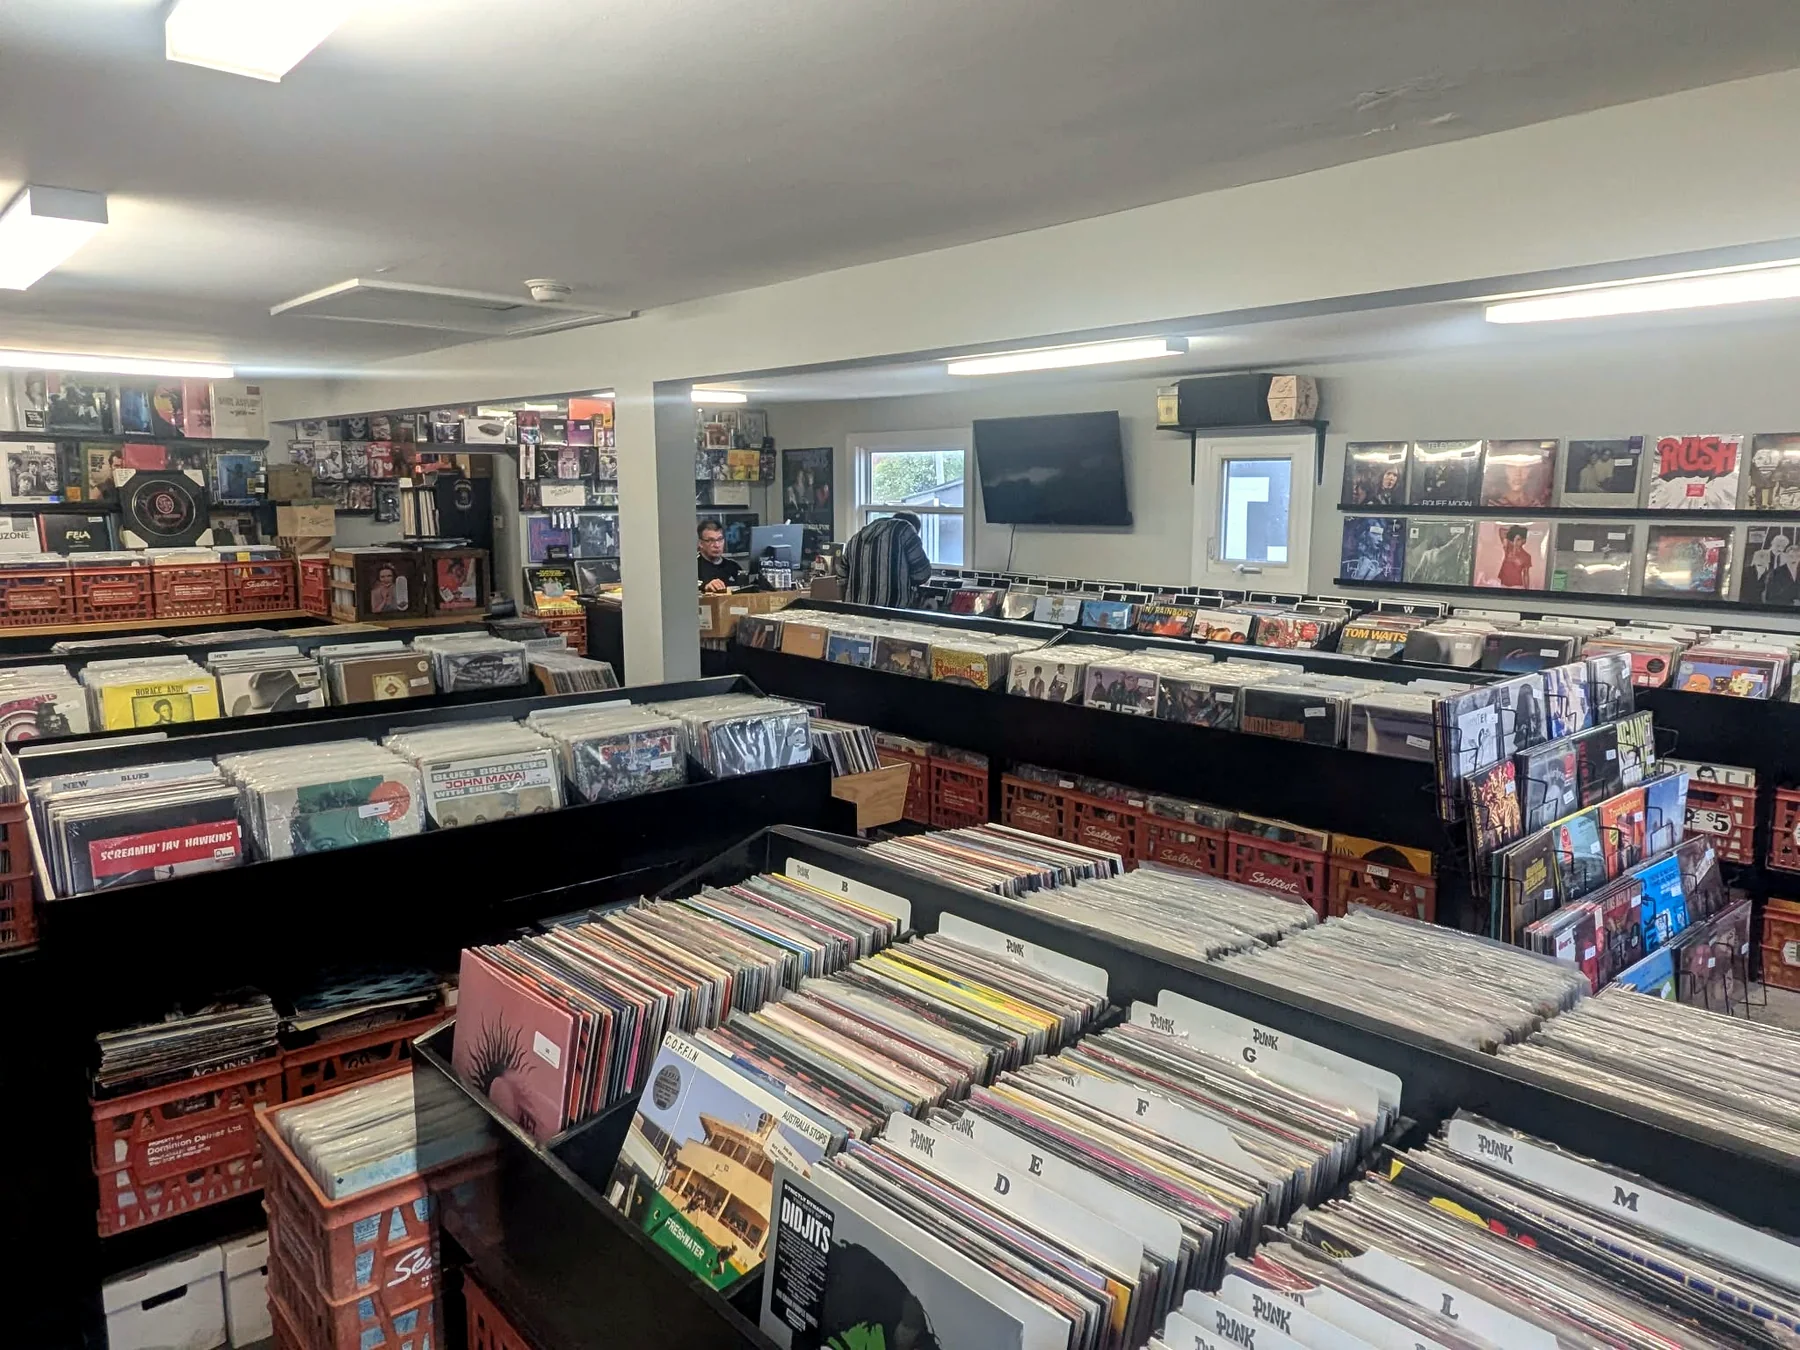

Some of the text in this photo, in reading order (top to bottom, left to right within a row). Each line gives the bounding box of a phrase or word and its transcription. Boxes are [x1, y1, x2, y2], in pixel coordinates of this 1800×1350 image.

[1657, 437, 1738, 476] RUSH
[1154, 606, 1194, 618] RAINBOWS
[1404, 606, 1415, 614] W
[1345, 627, 1408, 643] TOM WAITS
[135, 685, 184, 696] HORACE ANDY
[63, 772, 149, 791] NEW BLUES
[432, 760, 547, 782] BLUES BREAKERS
[435, 789, 465, 799] WITH
[469, 785, 495, 794] ERIC
[445, 778, 483, 790] JOHN
[1706, 812, 1729, 832] $5
[101, 832, 233, 861] SCREAMIN' JAY HAWKINS
[797, 865, 849, 893] PUNK B
[1249, 871, 1299, 894] Sealtest
[1006, 939, 1025, 958] PUNK
[1150, 1013, 1174, 1035] PUNK
[1253, 1028, 1279, 1051] PUNK
[1242, 1047, 1257, 1063] G
[1136, 1098, 1150, 1117] F
[782, 1110, 828, 1145] AUSTRALIA STOPS
[147, 1138, 192, 1155] Dominion
[194, 1130, 225, 1143] Dairies
[910, 1128, 1011, 1196] PUNK D
[1028, 1154, 1043, 1177] E
[1478, 1134, 1640, 1213] PUNK M
[781, 1196, 831, 1254] DIDJITS
[664, 1217, 705, 1260] FRESHWATER
[1252, 1293, 1293, 1335] PUNK
[1441, 1293, 1459, 1320] L
[1216, 1310, 1256, 1350] PUNK
